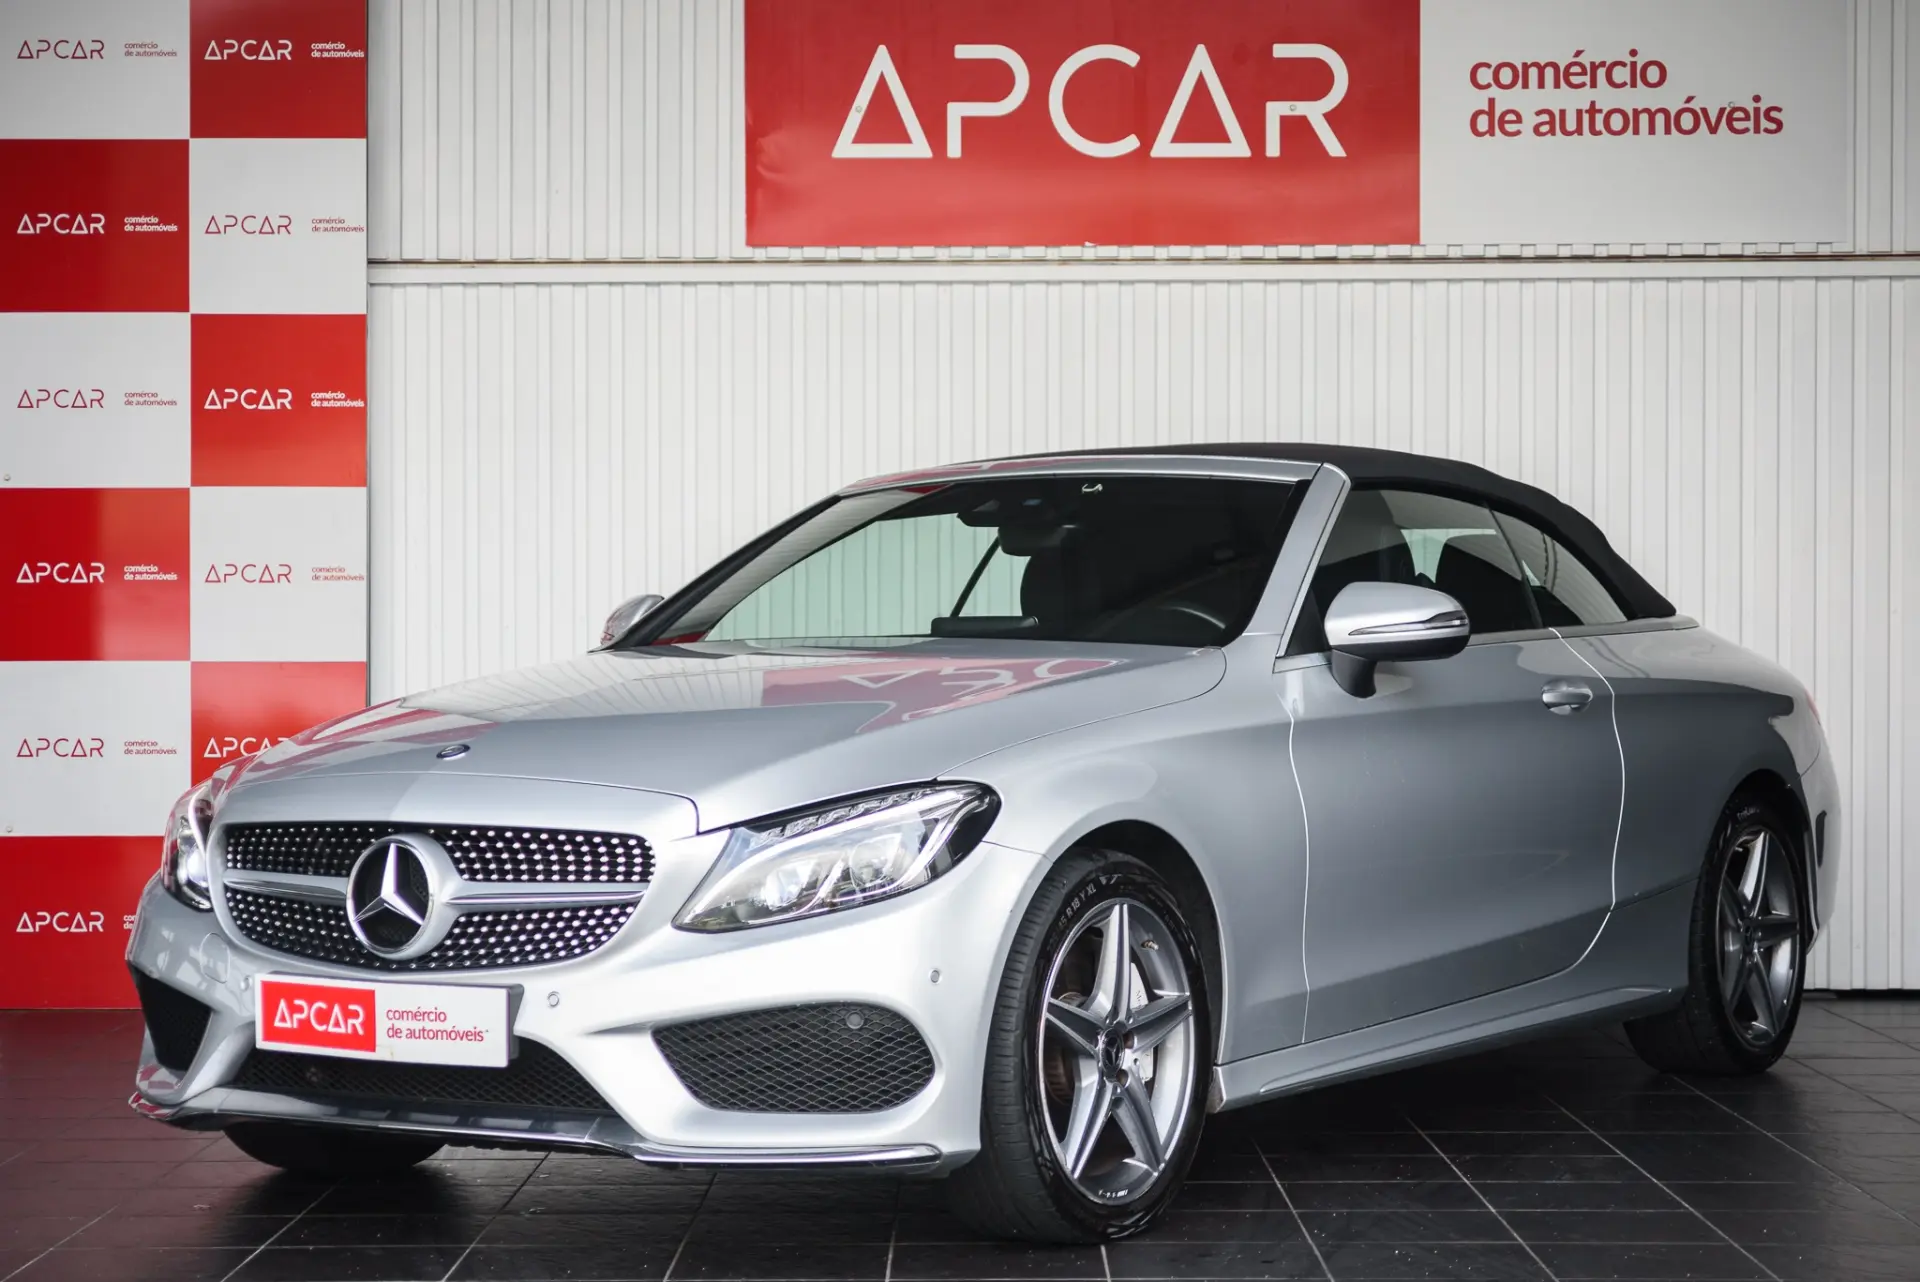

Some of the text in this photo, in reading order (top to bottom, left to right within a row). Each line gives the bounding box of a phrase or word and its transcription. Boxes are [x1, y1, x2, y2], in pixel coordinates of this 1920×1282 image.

[17, 40, 105, 60] APCAR
[124, 41, 158, 50] comércio
[204, 40, 292, 60] APCAR
[311, 42, 345, 50] comércio
[124, 49, 178, 58] de automóveis
[311, 50, 364, 58] de automóveis
[1469, 48, 1668, 91] comércio
[831, 44, 1348, 160] APCAR
[1469, 94, 1784, 138] de automóveis
[17, 214, 105, 234] APCAR
[124, 216, 158, 224] comércio
[312, 217, 346, 226] comércio
[124, 224, 178, 232] de automóveis
[204, 215, 292, 235] APCAR
[312, 225, 365, 234] de automóveis
[124, 390, 158, 398] comércio
[311, 390, 345, 399] comércio
[17, 389, 105, 409] APCAR
[124, 398, 178, 406] de automóveis
[204, 389, 292, 409] APCAR
[311, 398, 364, 407] de automóveis
[17, 563, 105, 583] APCAR
[124, 564, 158, 573] comércio
[312, 566, 346, 574] comércio
[124, 572, 178, 581] de automóveis
[204, 564, 292, 584] APCAR
[312, 574, 365, 582] de automóveis
[17, 738, 105, 758] APCAR
[124, 739, 158, 748] comércio
[124, 747, 178, 756] de automóveis
[16, 912, 105, 932] APCAR
[274, 998, 364, 1035] APCAR
[386, 1007, 447, 1022] comércio
[387, 1023, 484, 1042] de automóveis
